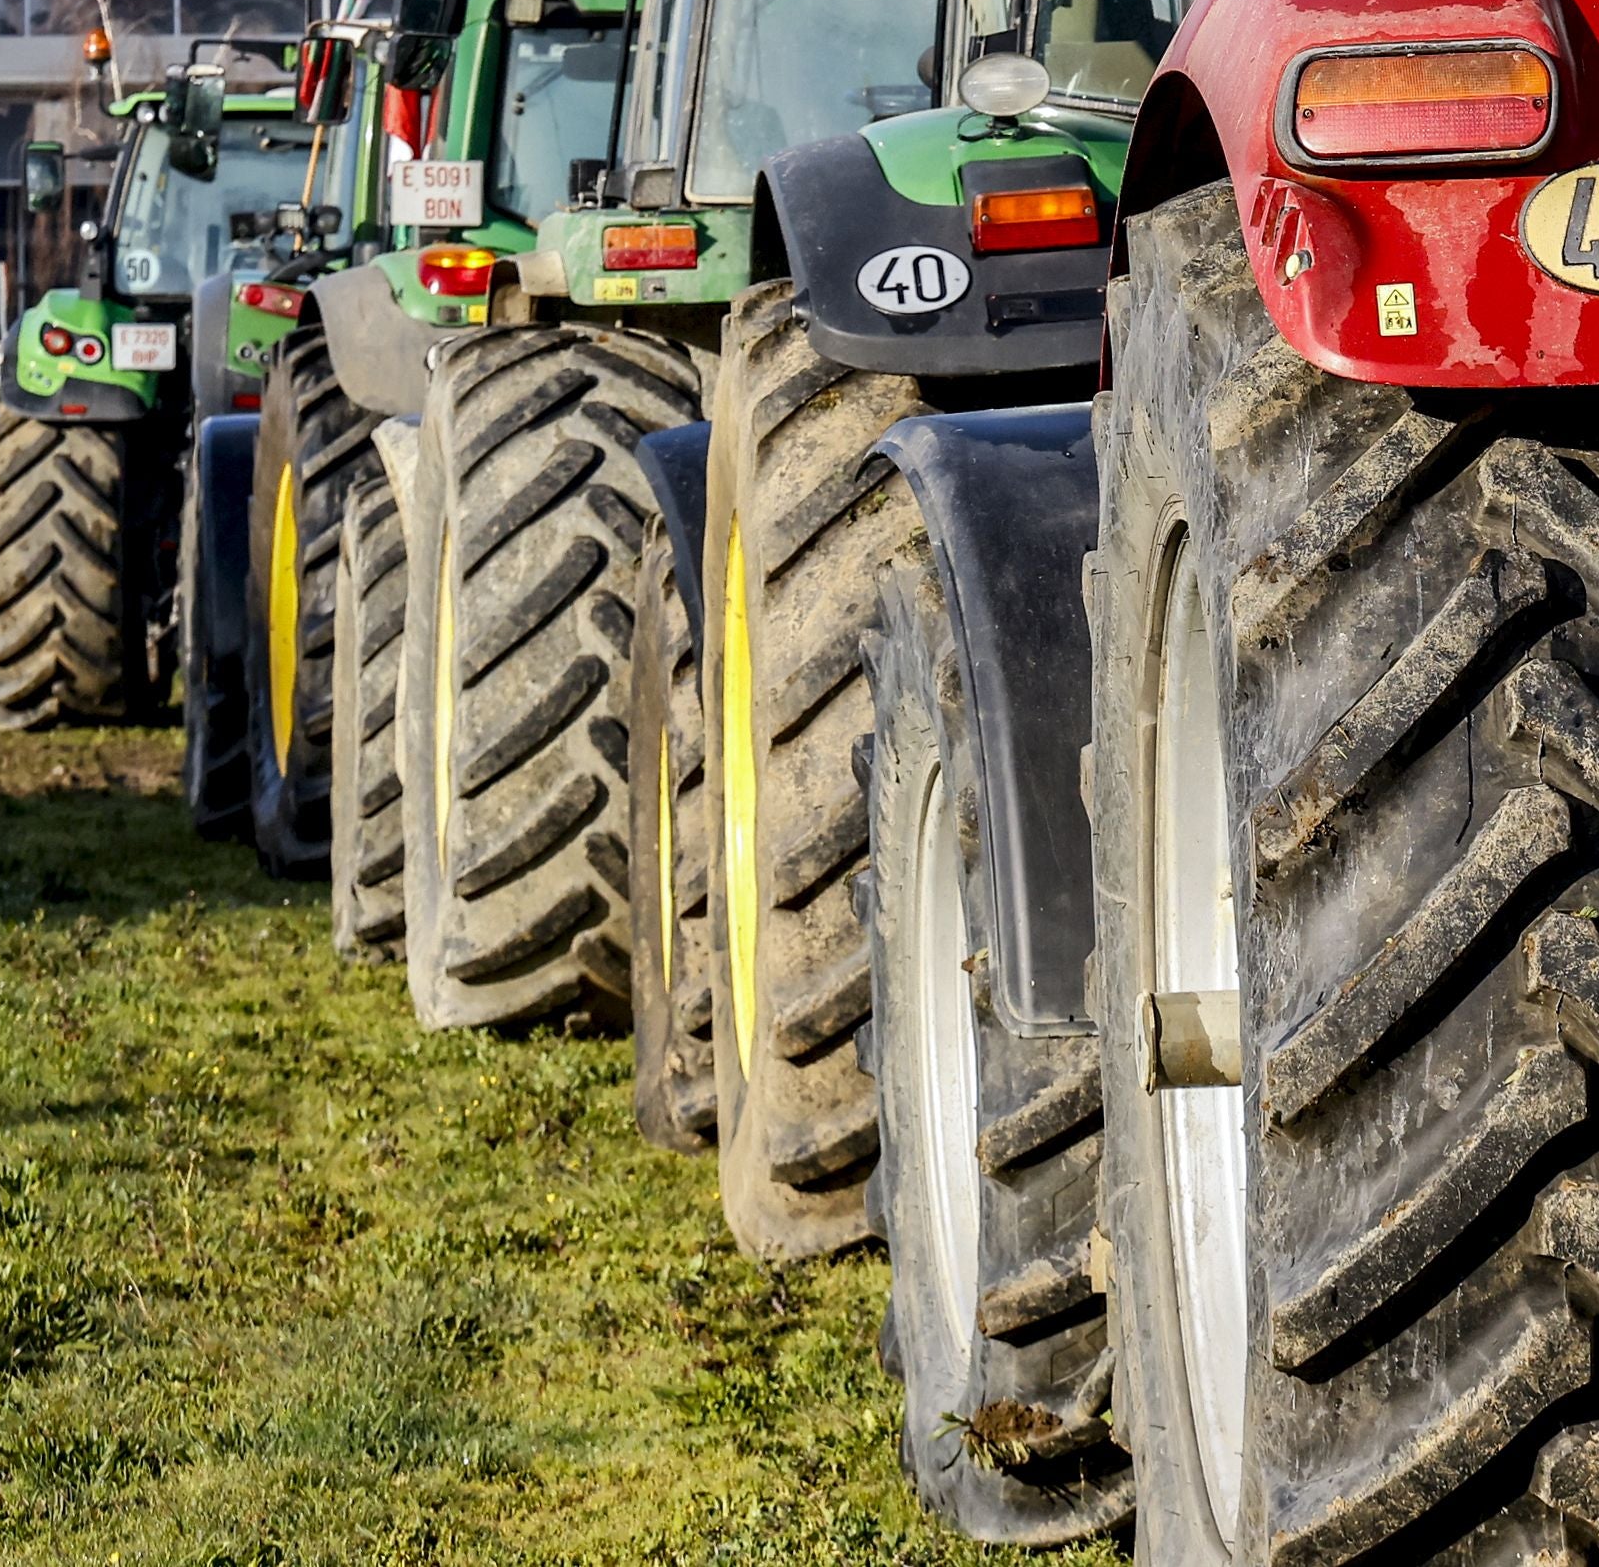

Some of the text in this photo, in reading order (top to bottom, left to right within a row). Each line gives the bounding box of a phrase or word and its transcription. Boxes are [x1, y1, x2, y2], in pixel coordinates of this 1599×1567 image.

[403, 166, 470, 187] E 5091
[127, 258, 150, 282] 50
[876, 253, 948, 305] 40
